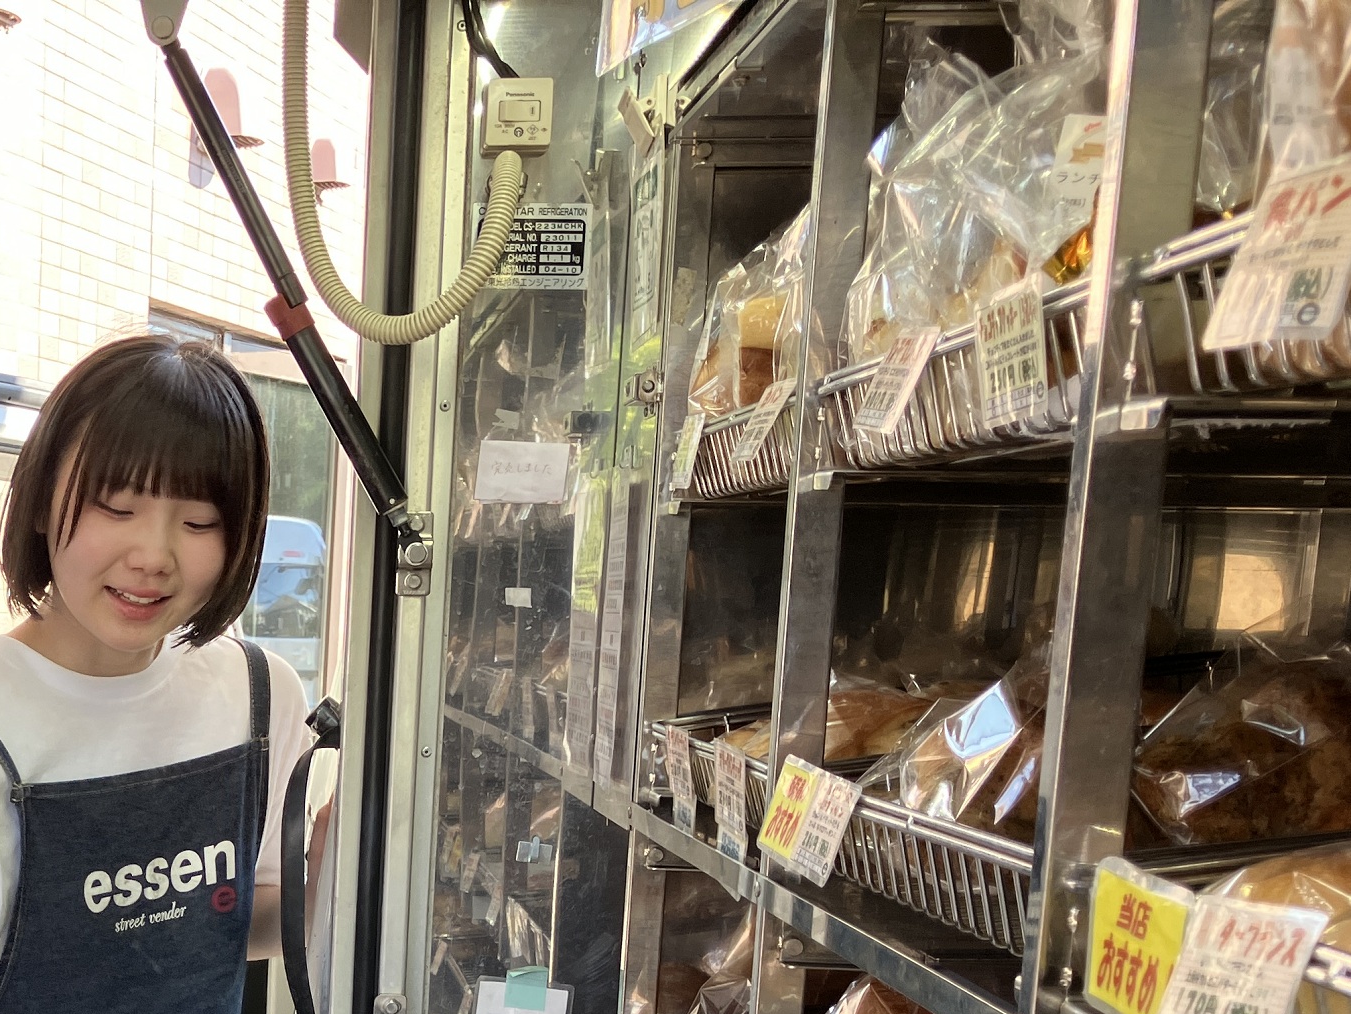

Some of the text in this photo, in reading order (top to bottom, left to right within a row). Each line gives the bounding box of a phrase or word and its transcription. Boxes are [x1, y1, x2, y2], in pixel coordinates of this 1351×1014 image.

[539, 207, 587, 216] REFRIGERATION
[504, 244, 537, 252] GERANT
[507, 254, 537, 263] CHARGE
[544, 266, 577, 274] 04-10
[84, 840, 236, 913] essen
[115, 901, 187, 932] street vender
[1116, 893, 1153, 940] 当店
